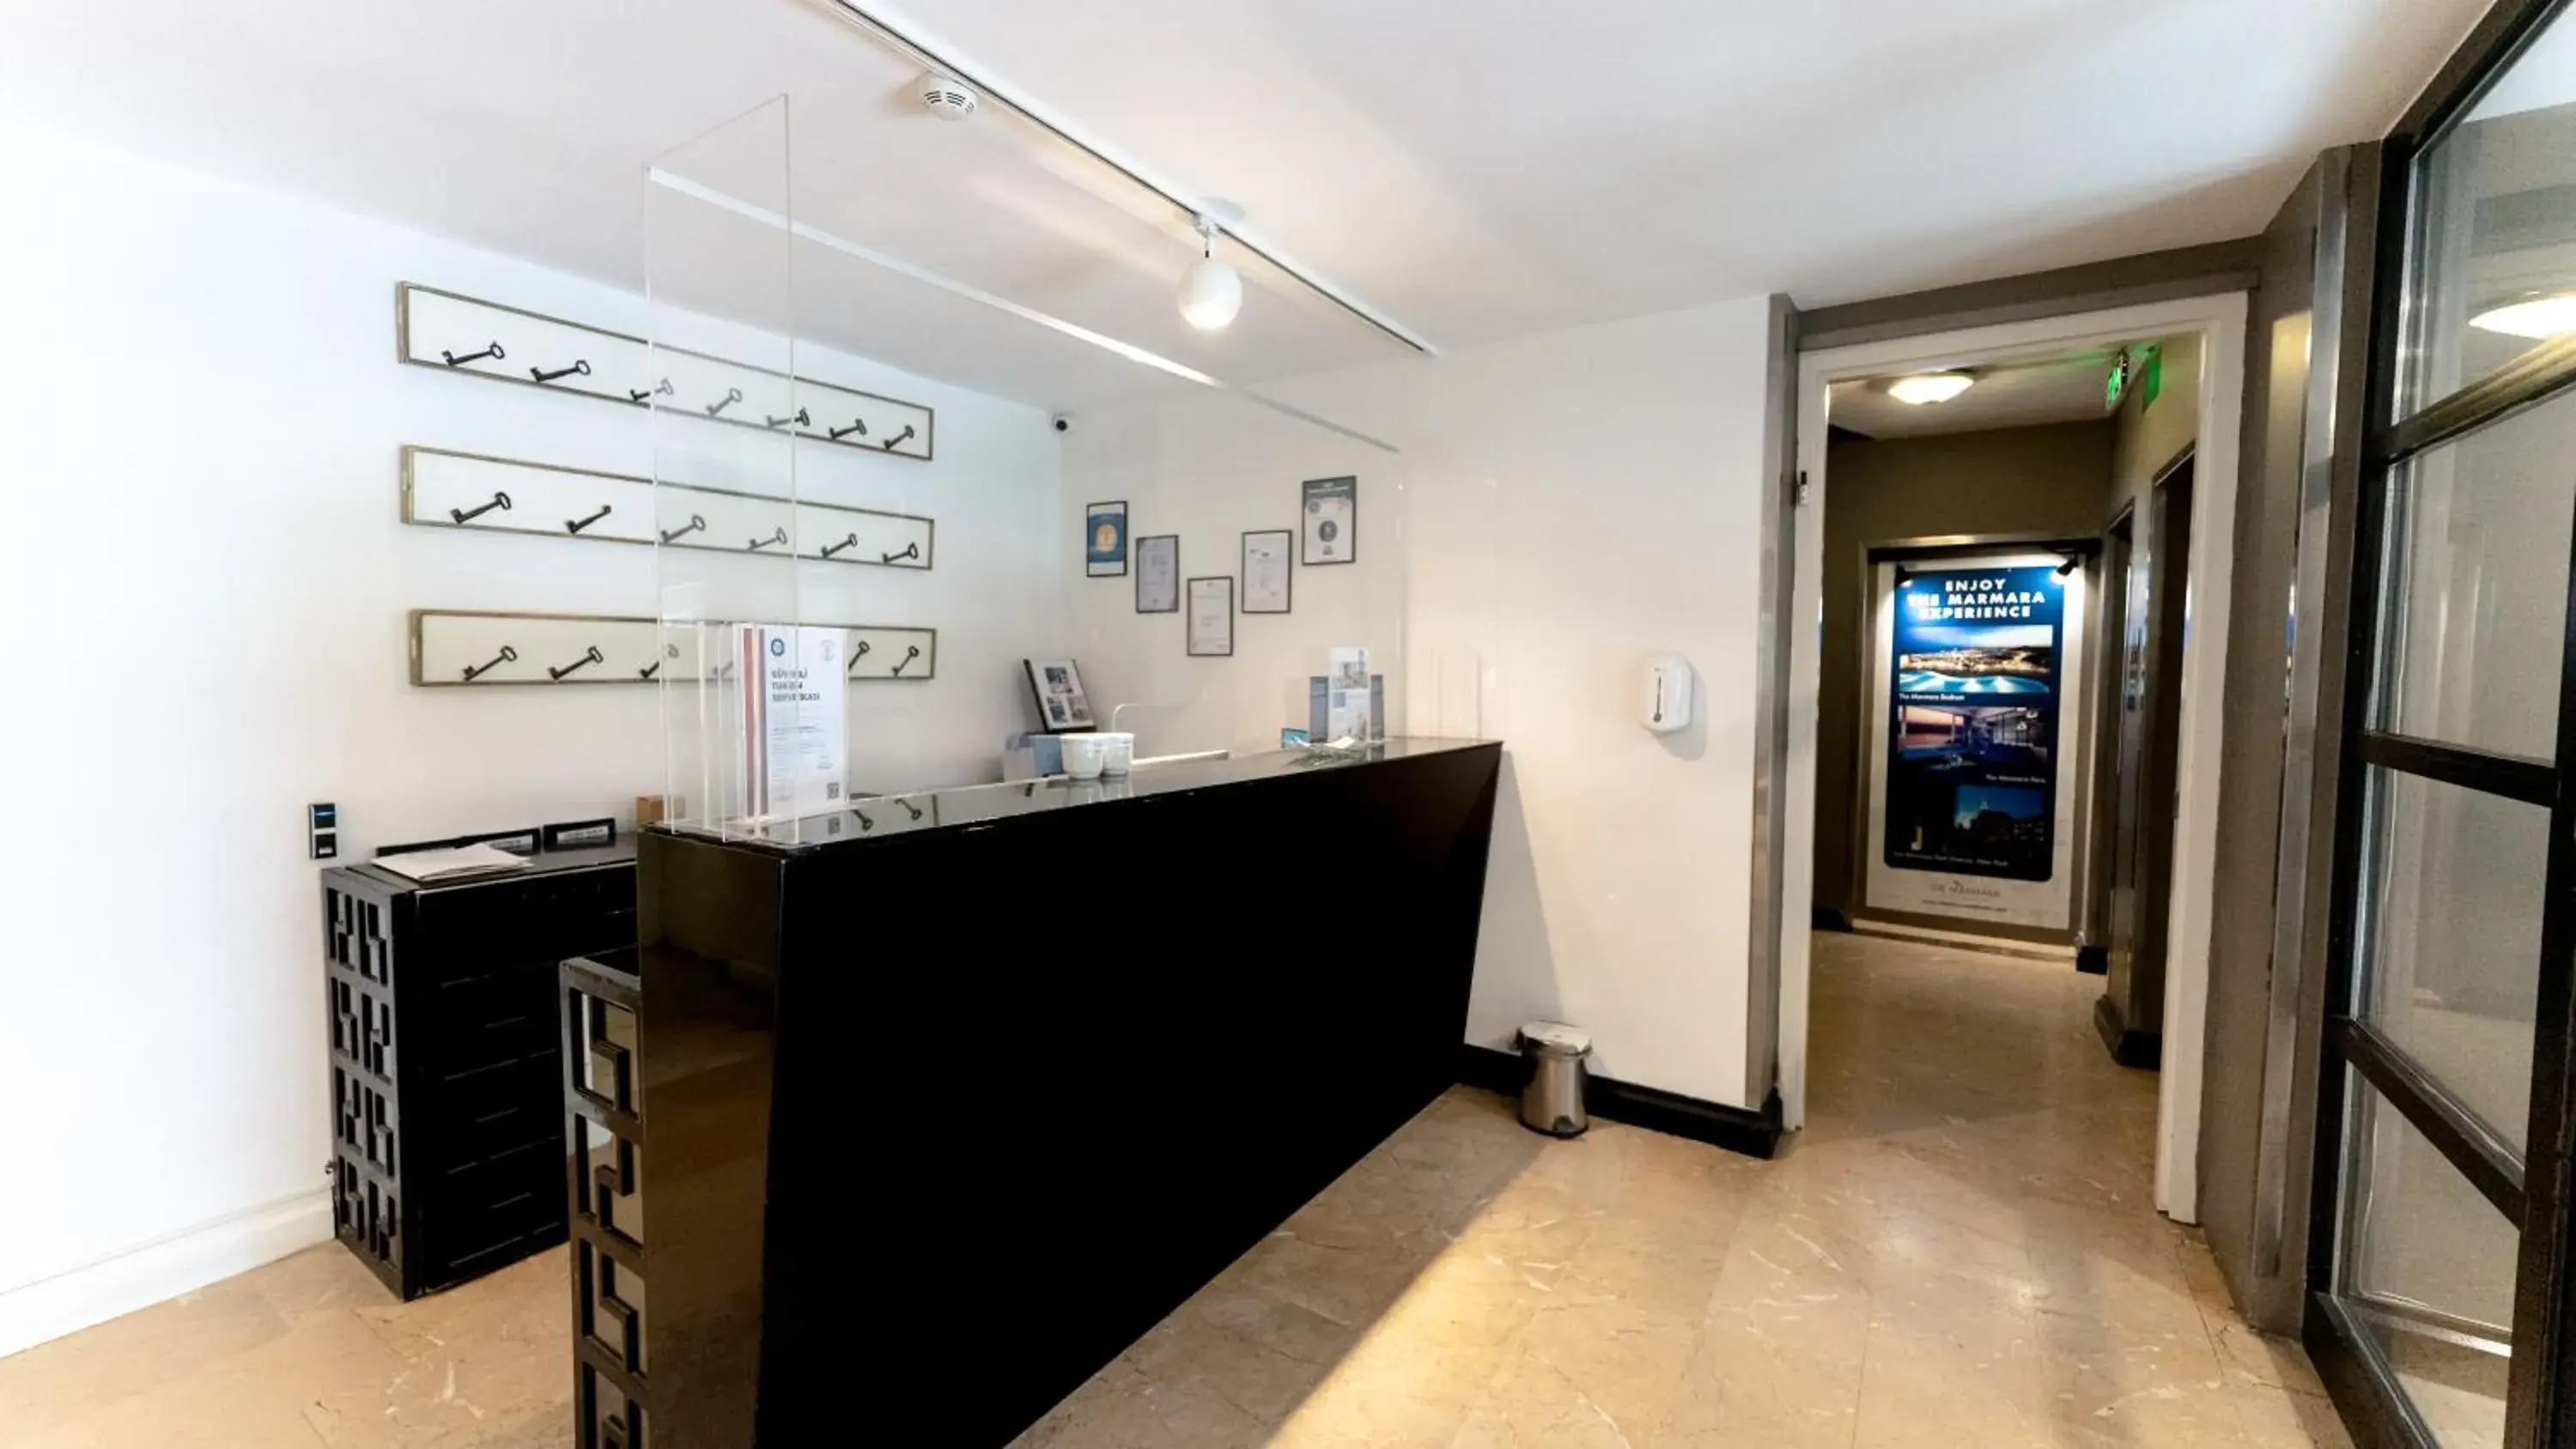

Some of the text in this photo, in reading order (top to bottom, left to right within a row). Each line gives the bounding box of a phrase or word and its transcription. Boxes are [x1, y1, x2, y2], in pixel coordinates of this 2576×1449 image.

[1945, 579, 2007, 592] ENJOY
[1947, 591, 2045, 605] MARMARA
[1919, 605, 2031, 619] EXPERIENCE
